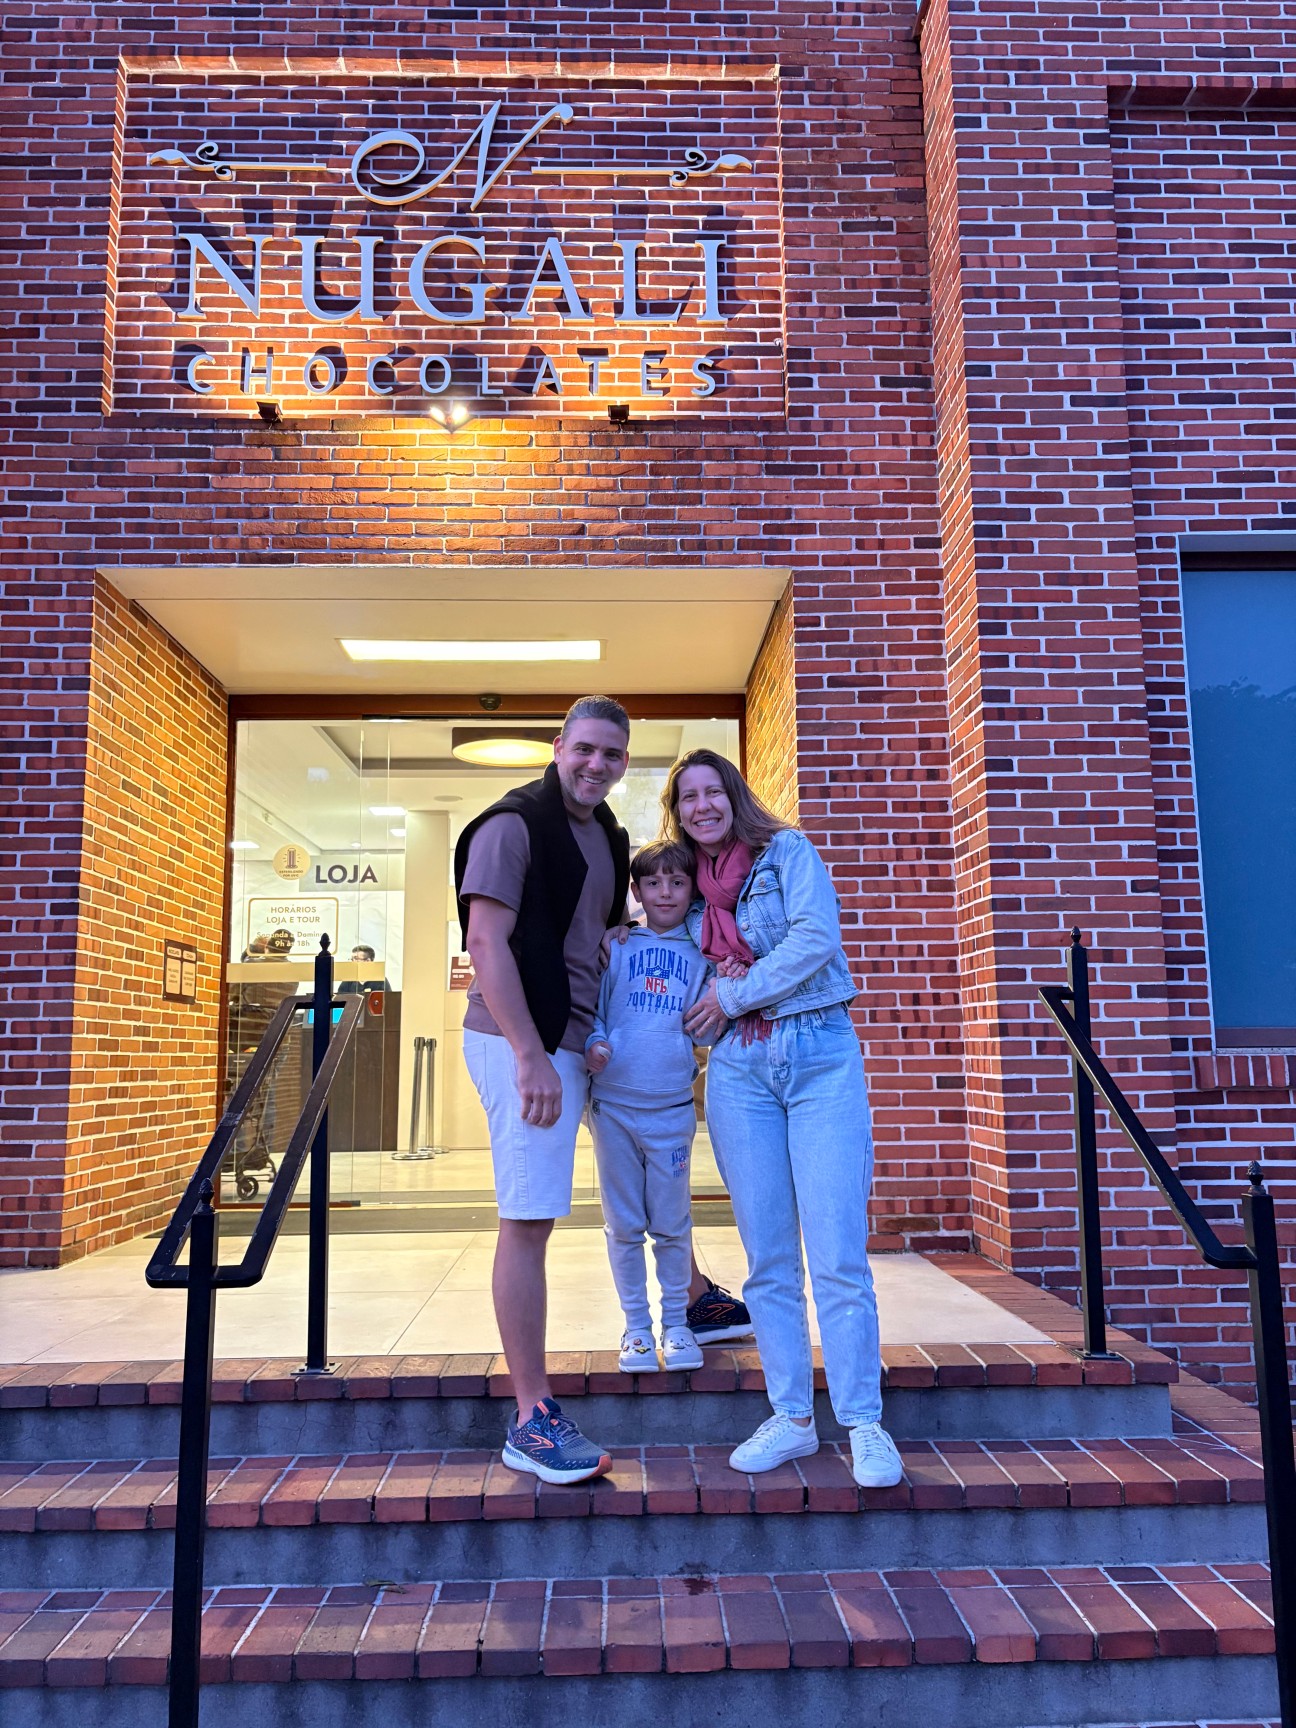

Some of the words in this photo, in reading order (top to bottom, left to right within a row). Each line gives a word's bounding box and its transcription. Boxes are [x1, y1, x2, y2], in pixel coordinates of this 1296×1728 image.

[176, 232, 728, 325] NUGALI
[187, 353, 716, 397] CHOCOLATES
[315, 864, 378, 884] LOJA
[270, 904, 317, 914] HORÁRIOS
[266, 916, 287, 925] LOJA
[629, 947, 689, 987] NATIONAL
[645, 976, 668, 994] NFL
[626, 991, 683, 1012] FOOTBALL
